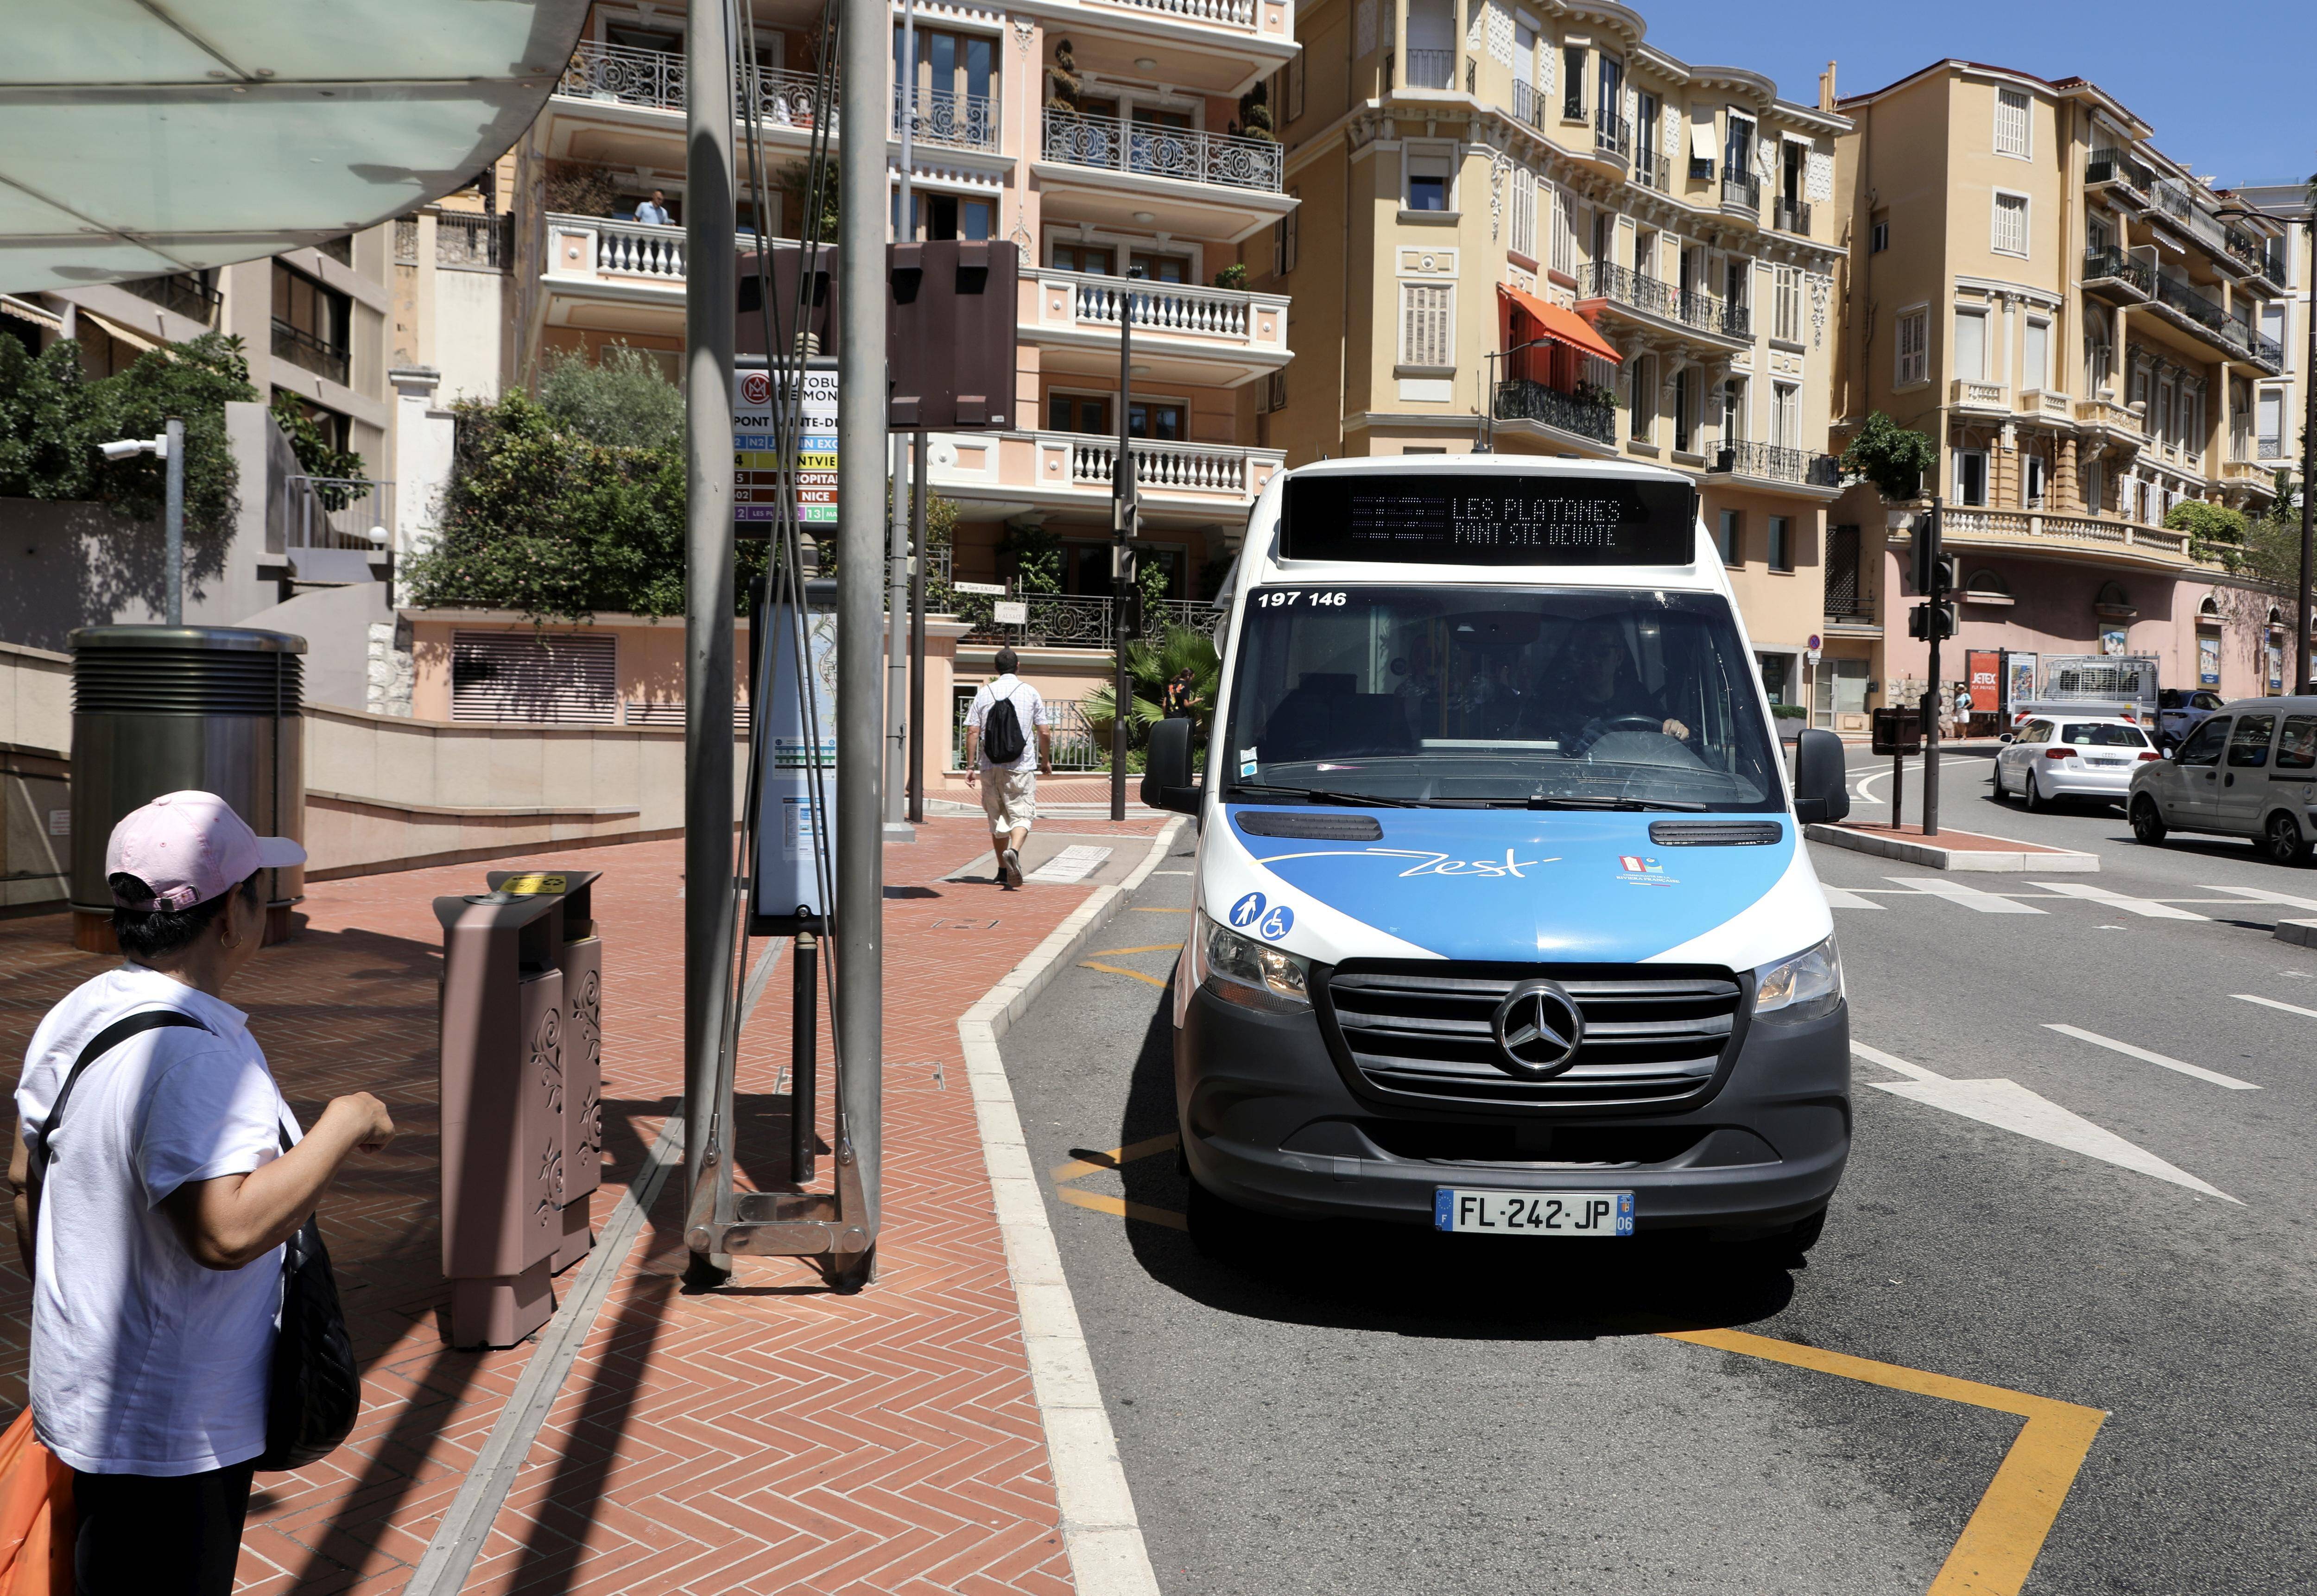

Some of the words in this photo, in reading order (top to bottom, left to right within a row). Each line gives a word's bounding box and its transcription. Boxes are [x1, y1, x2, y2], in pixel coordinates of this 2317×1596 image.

[734, 416, 770, 426] PONT
[737, 474, 743, 482] 5
[802, 492, 829, 501] NICE
[808, 510, 821, 518] 13
[1453, 498, 1494, 519] LES
[1505, 498, 1620, 521] PLATANES
[1455, 522, 1502, 544] PONT
[1509, 523, 1542, 544] STE
[1549, 524, 1616, 546] DEVOTE
[1258, 592, 1301, 607] 197
[1309, 592, 1347, 606] 146
[1972, 672, 1996, 684] JETEX
[1461, 1197, 1609, 1229] FL-242-JP
[1617, 1217, 1632, 1230] 06
